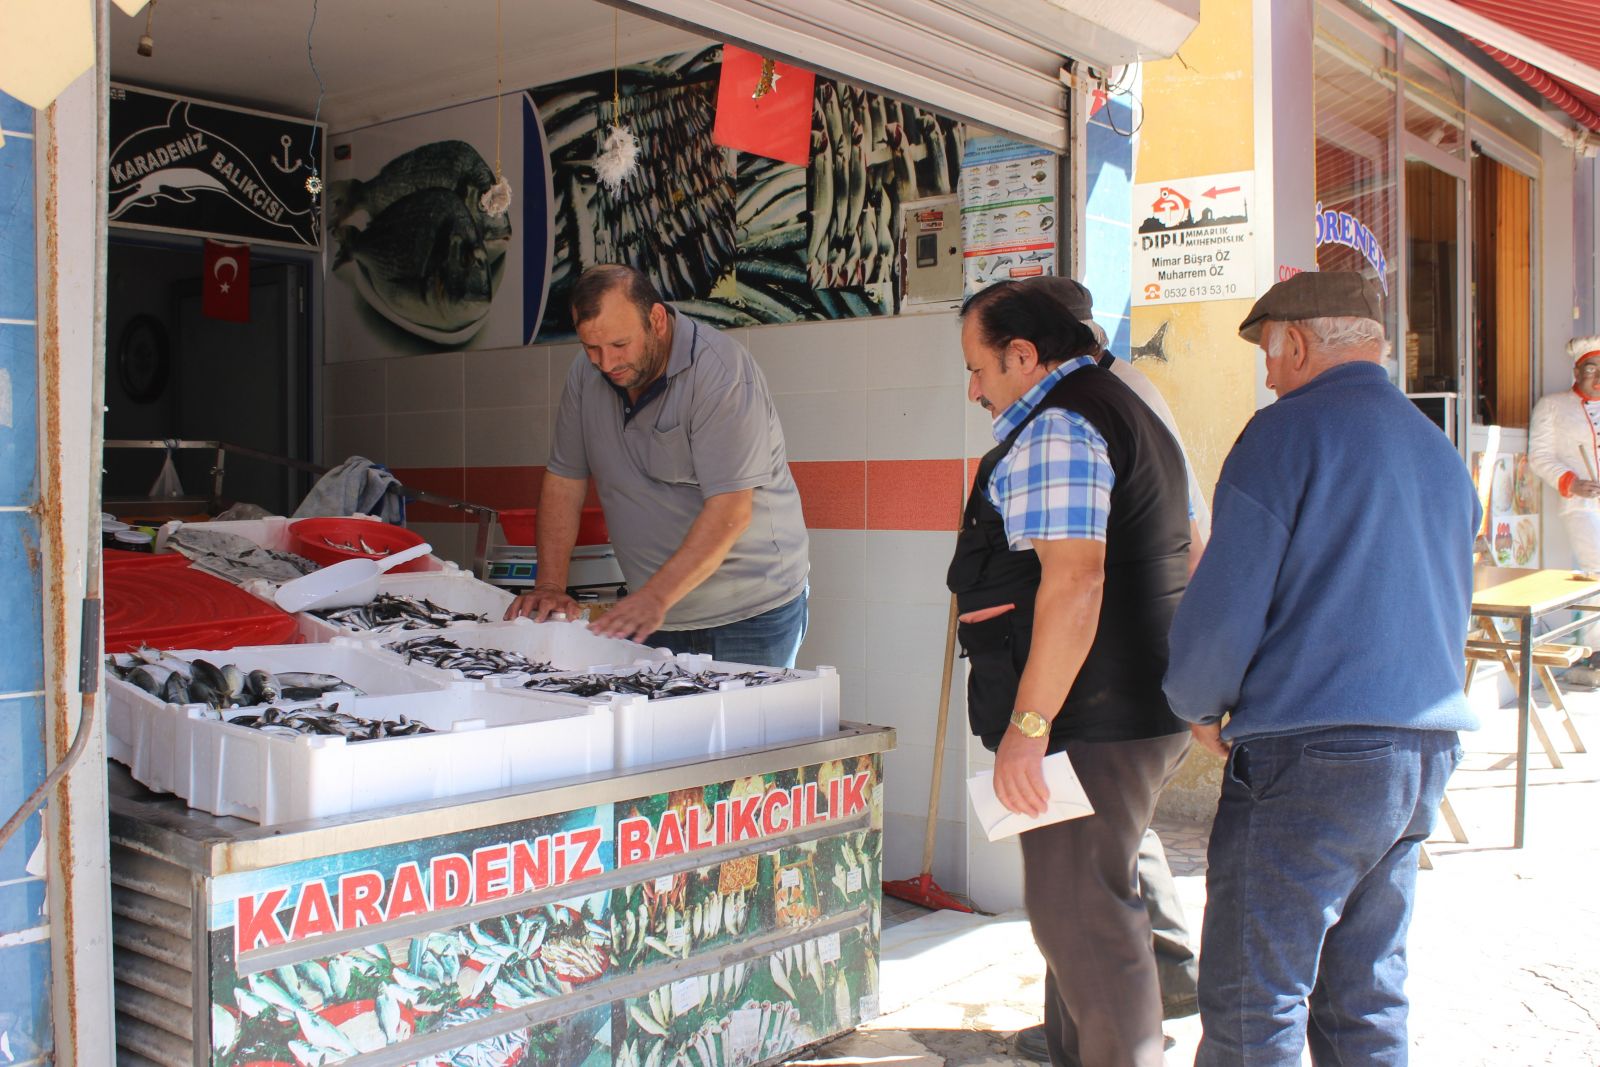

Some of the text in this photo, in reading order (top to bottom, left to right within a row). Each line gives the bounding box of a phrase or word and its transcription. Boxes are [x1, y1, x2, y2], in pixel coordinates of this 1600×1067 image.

[210, 151, 285, 222] BALIKÇISI
[1152, 250, 1230, 268] Mimar Büşra ÖZ
[1158, 265, 1224, 281] Muharrem ÖZ
[1164, 287, 1187, 299] 0532
[1189, 285, 1207, 297] 613
